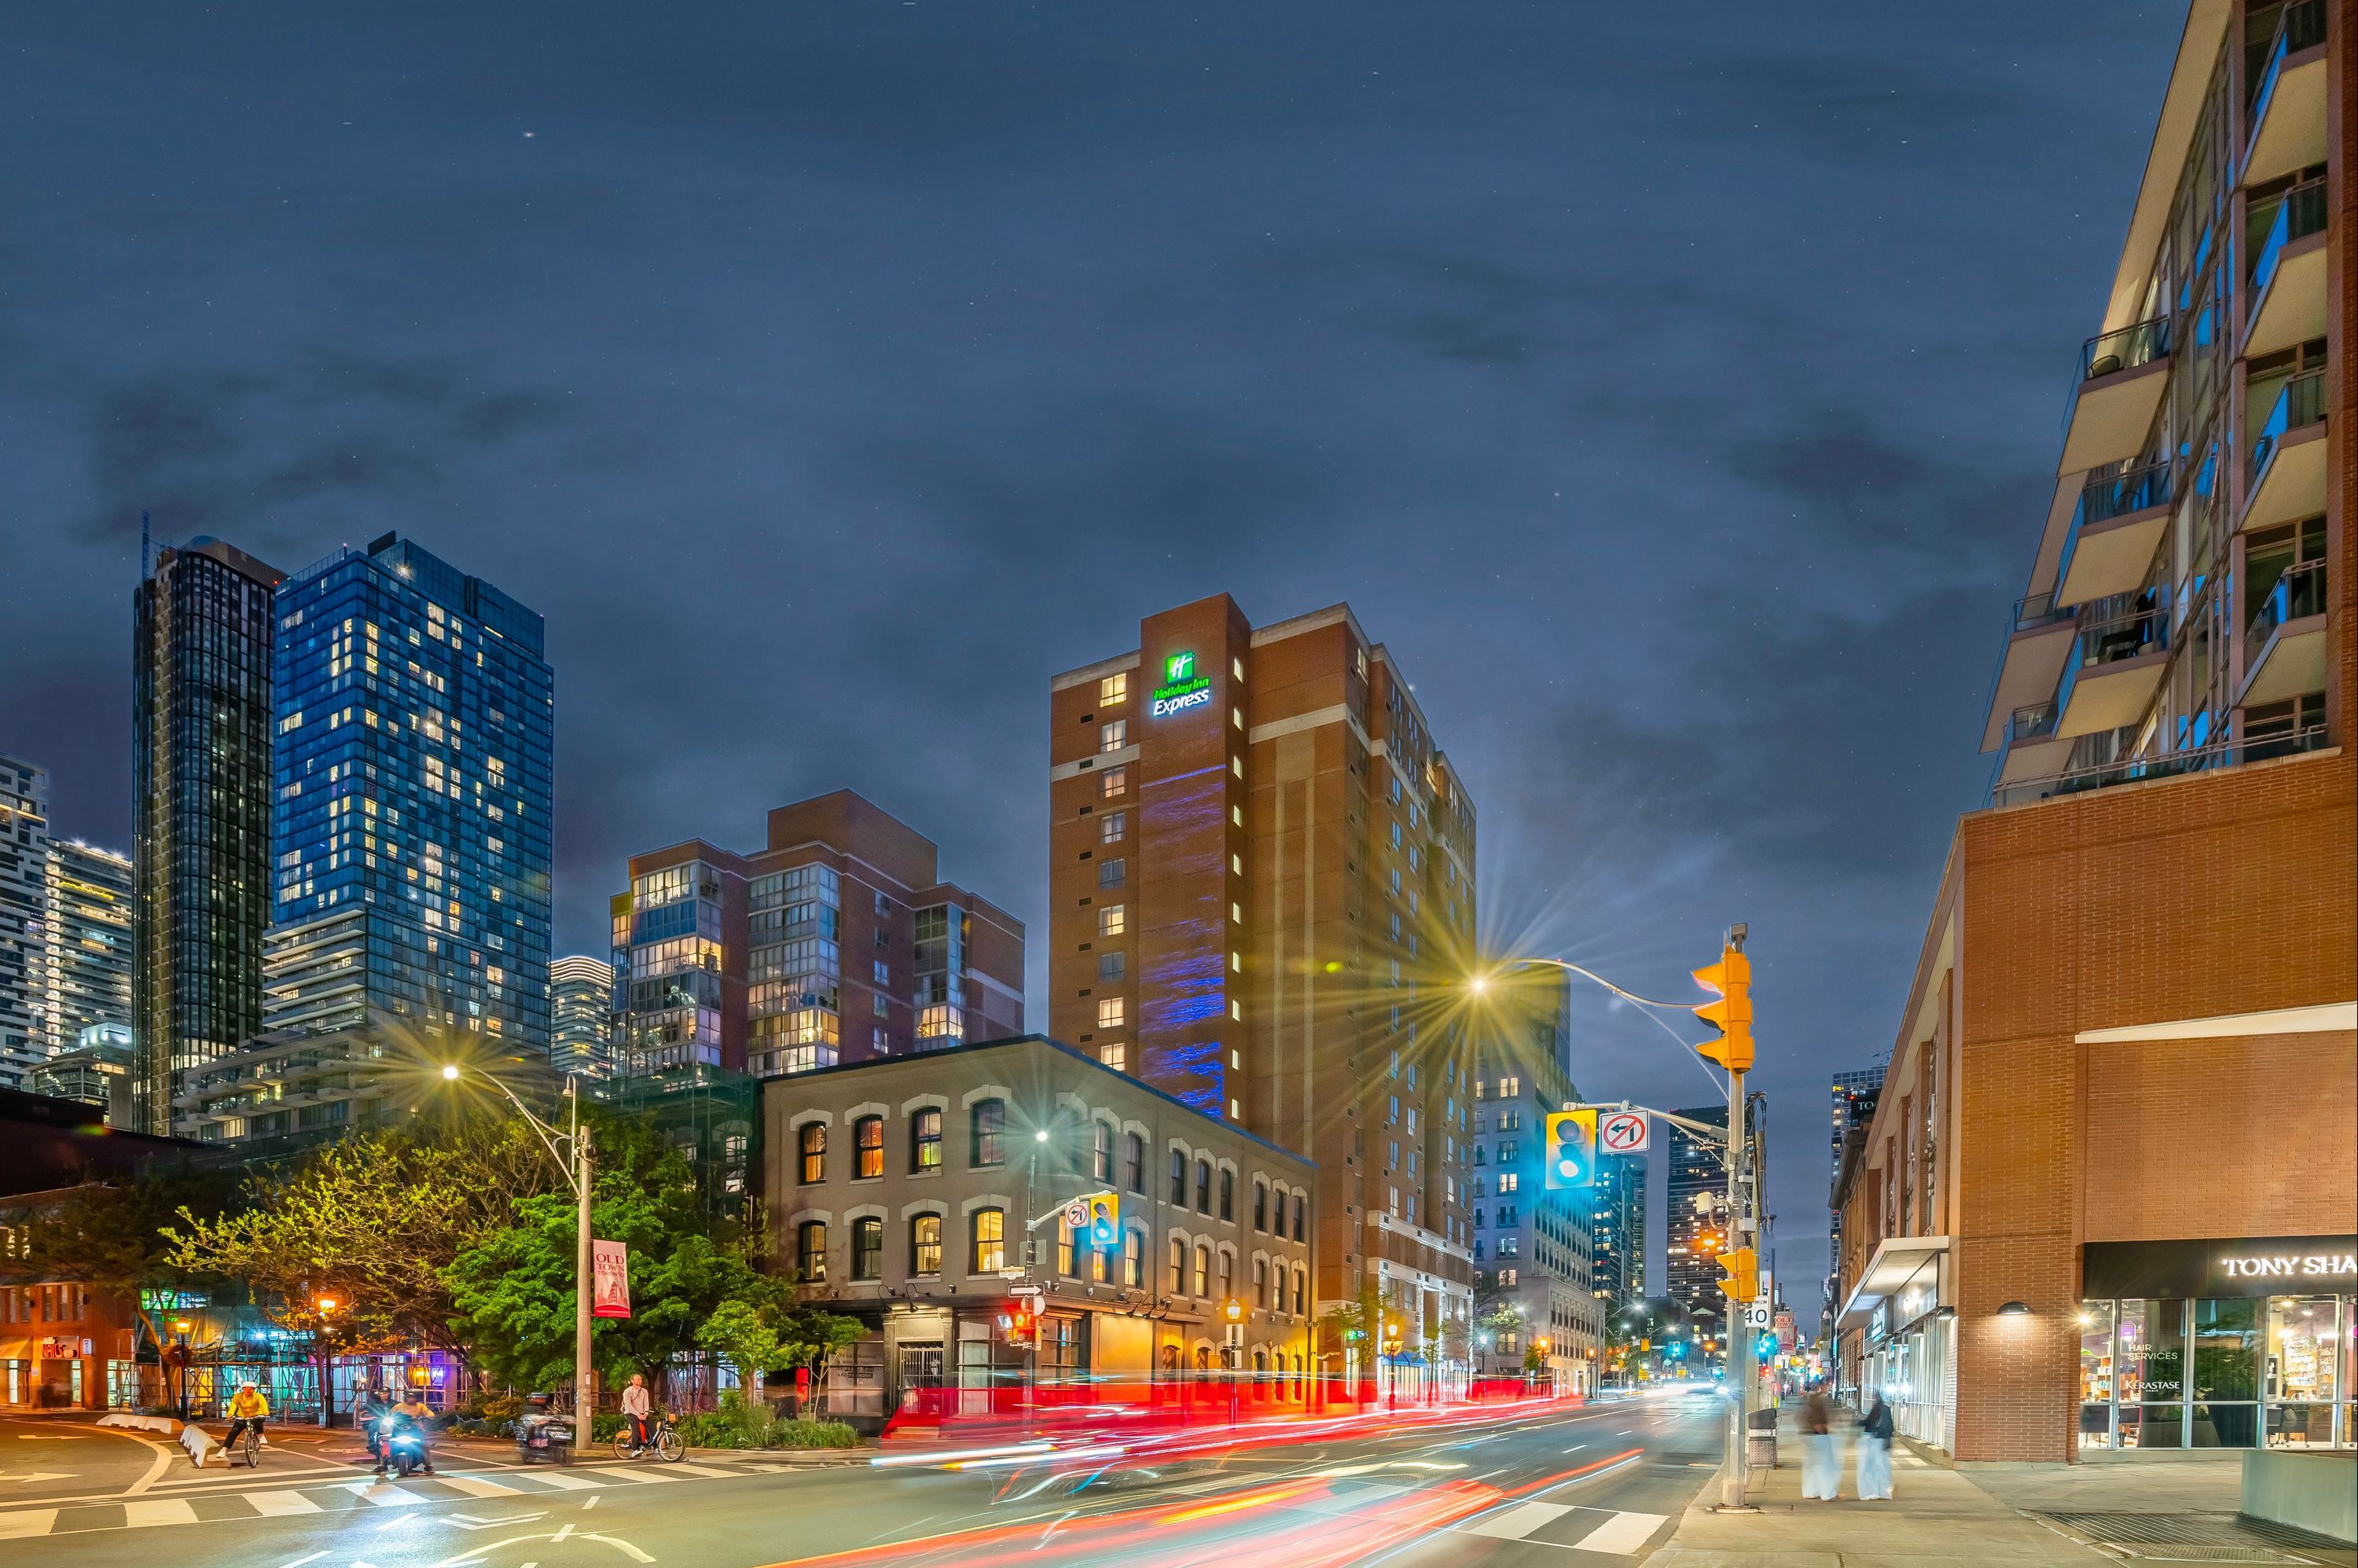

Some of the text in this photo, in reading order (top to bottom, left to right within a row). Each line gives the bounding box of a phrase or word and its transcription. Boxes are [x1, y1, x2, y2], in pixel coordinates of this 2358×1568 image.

[1154, 678, 1210, 700] Holiday Inn
[1154, 689, 1210, 715] Express
[1857, 1101, 1876, 1111] TO
[597, 1253, 625, 1265] OLD
[2222, 1255, 2357, 1276] TONY SHA
[1745, 1309, 1767, 1324] 40
[42, 1344, 63, 1357] NAILS
